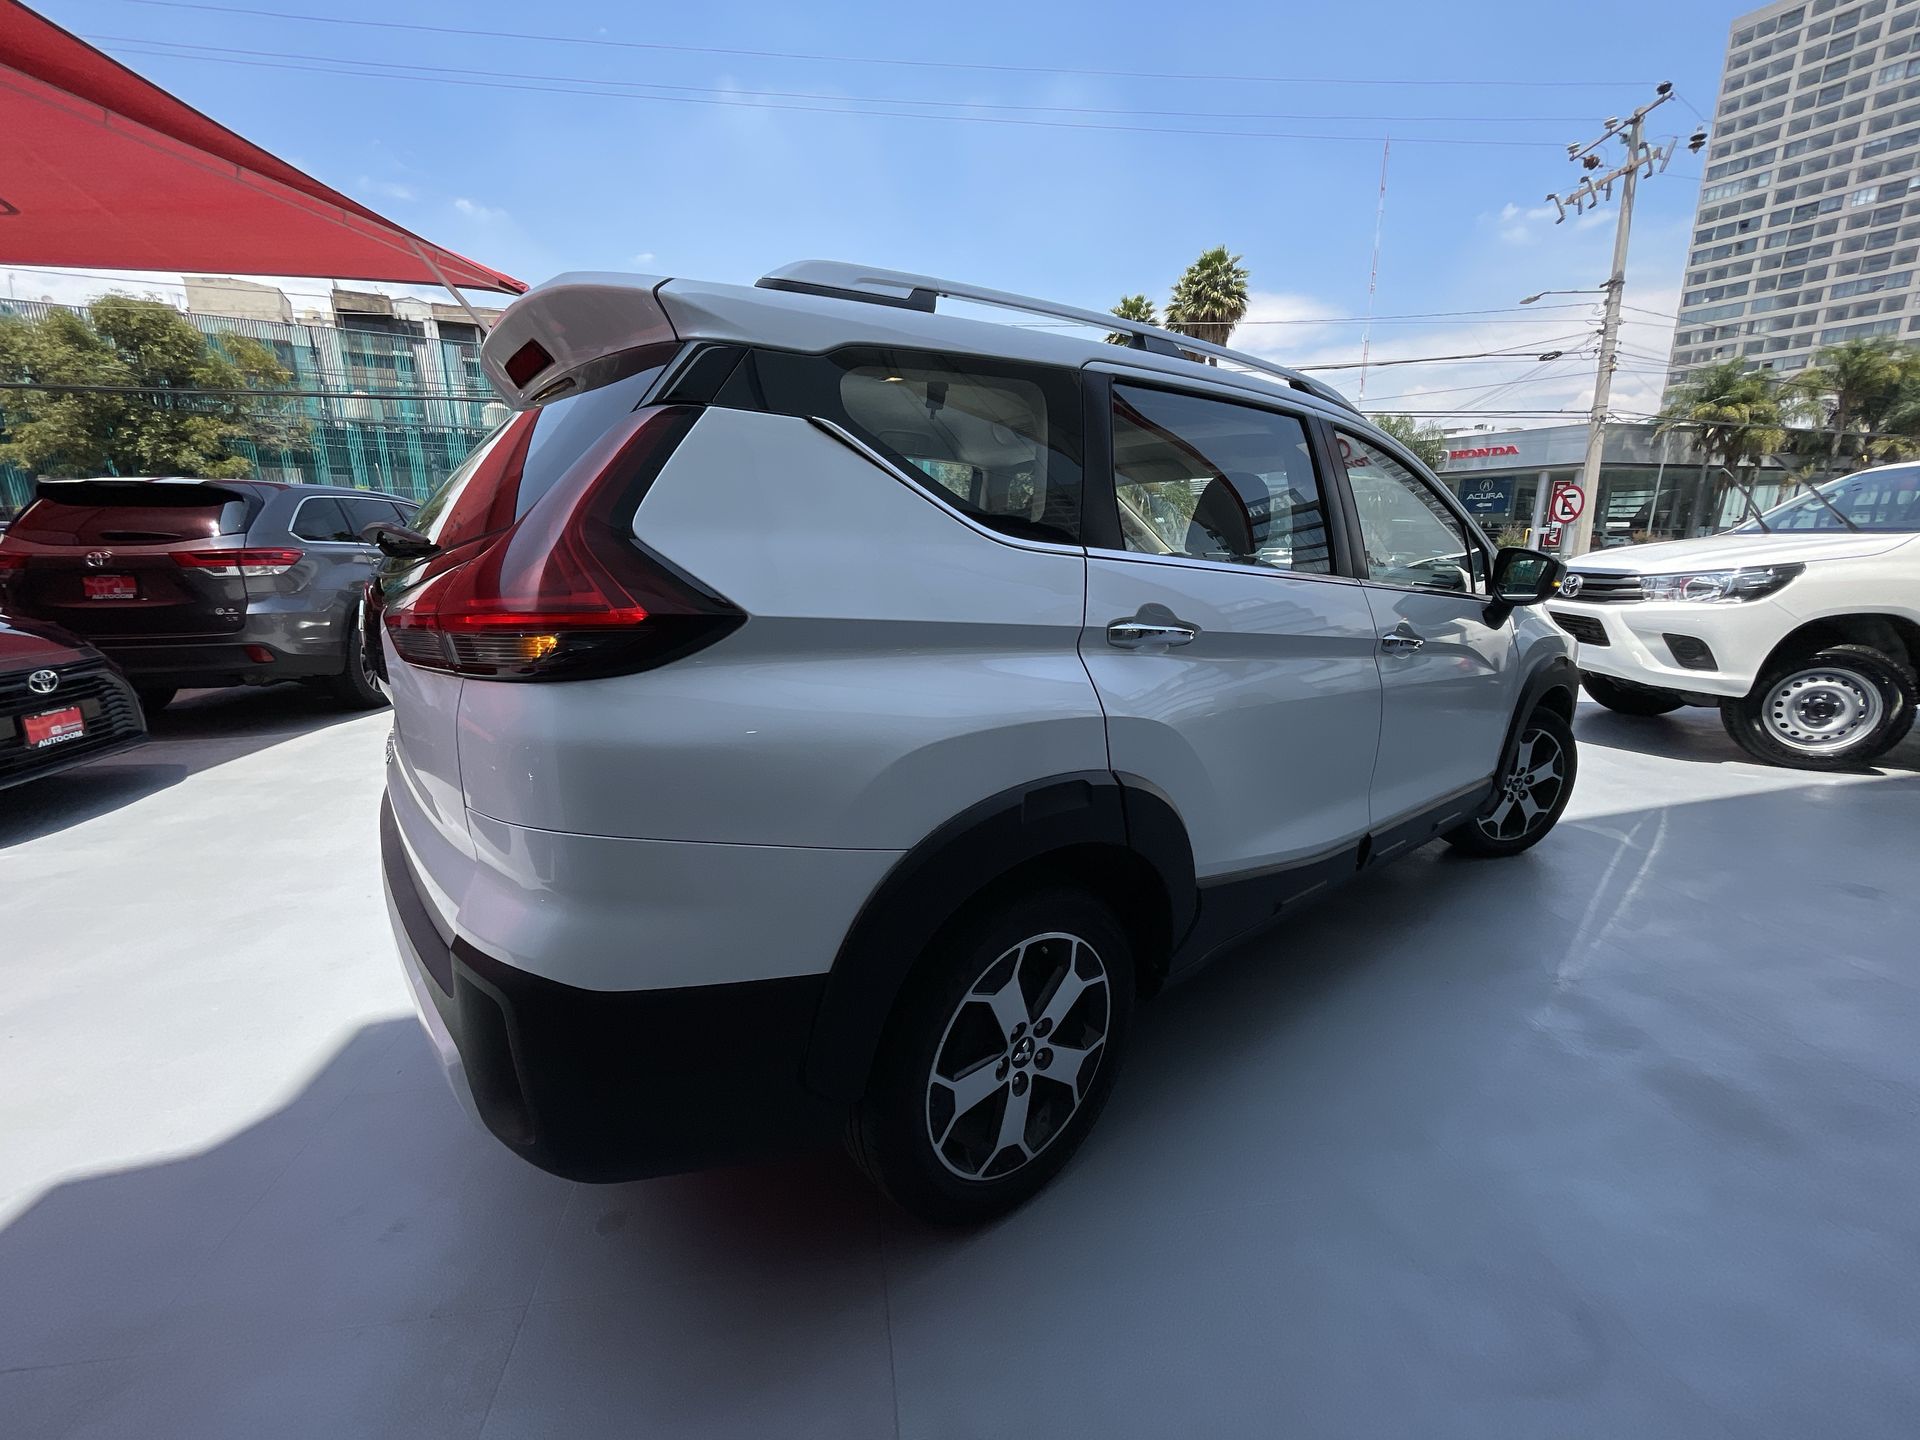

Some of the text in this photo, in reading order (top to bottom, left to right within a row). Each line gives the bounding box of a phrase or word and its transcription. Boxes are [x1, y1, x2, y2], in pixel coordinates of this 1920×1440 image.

[1449, 444, 1519, 460] HONDA
[1466, 491, 1504, 500] ACURA
[38, 730, 83, 748] AUTOCOM
